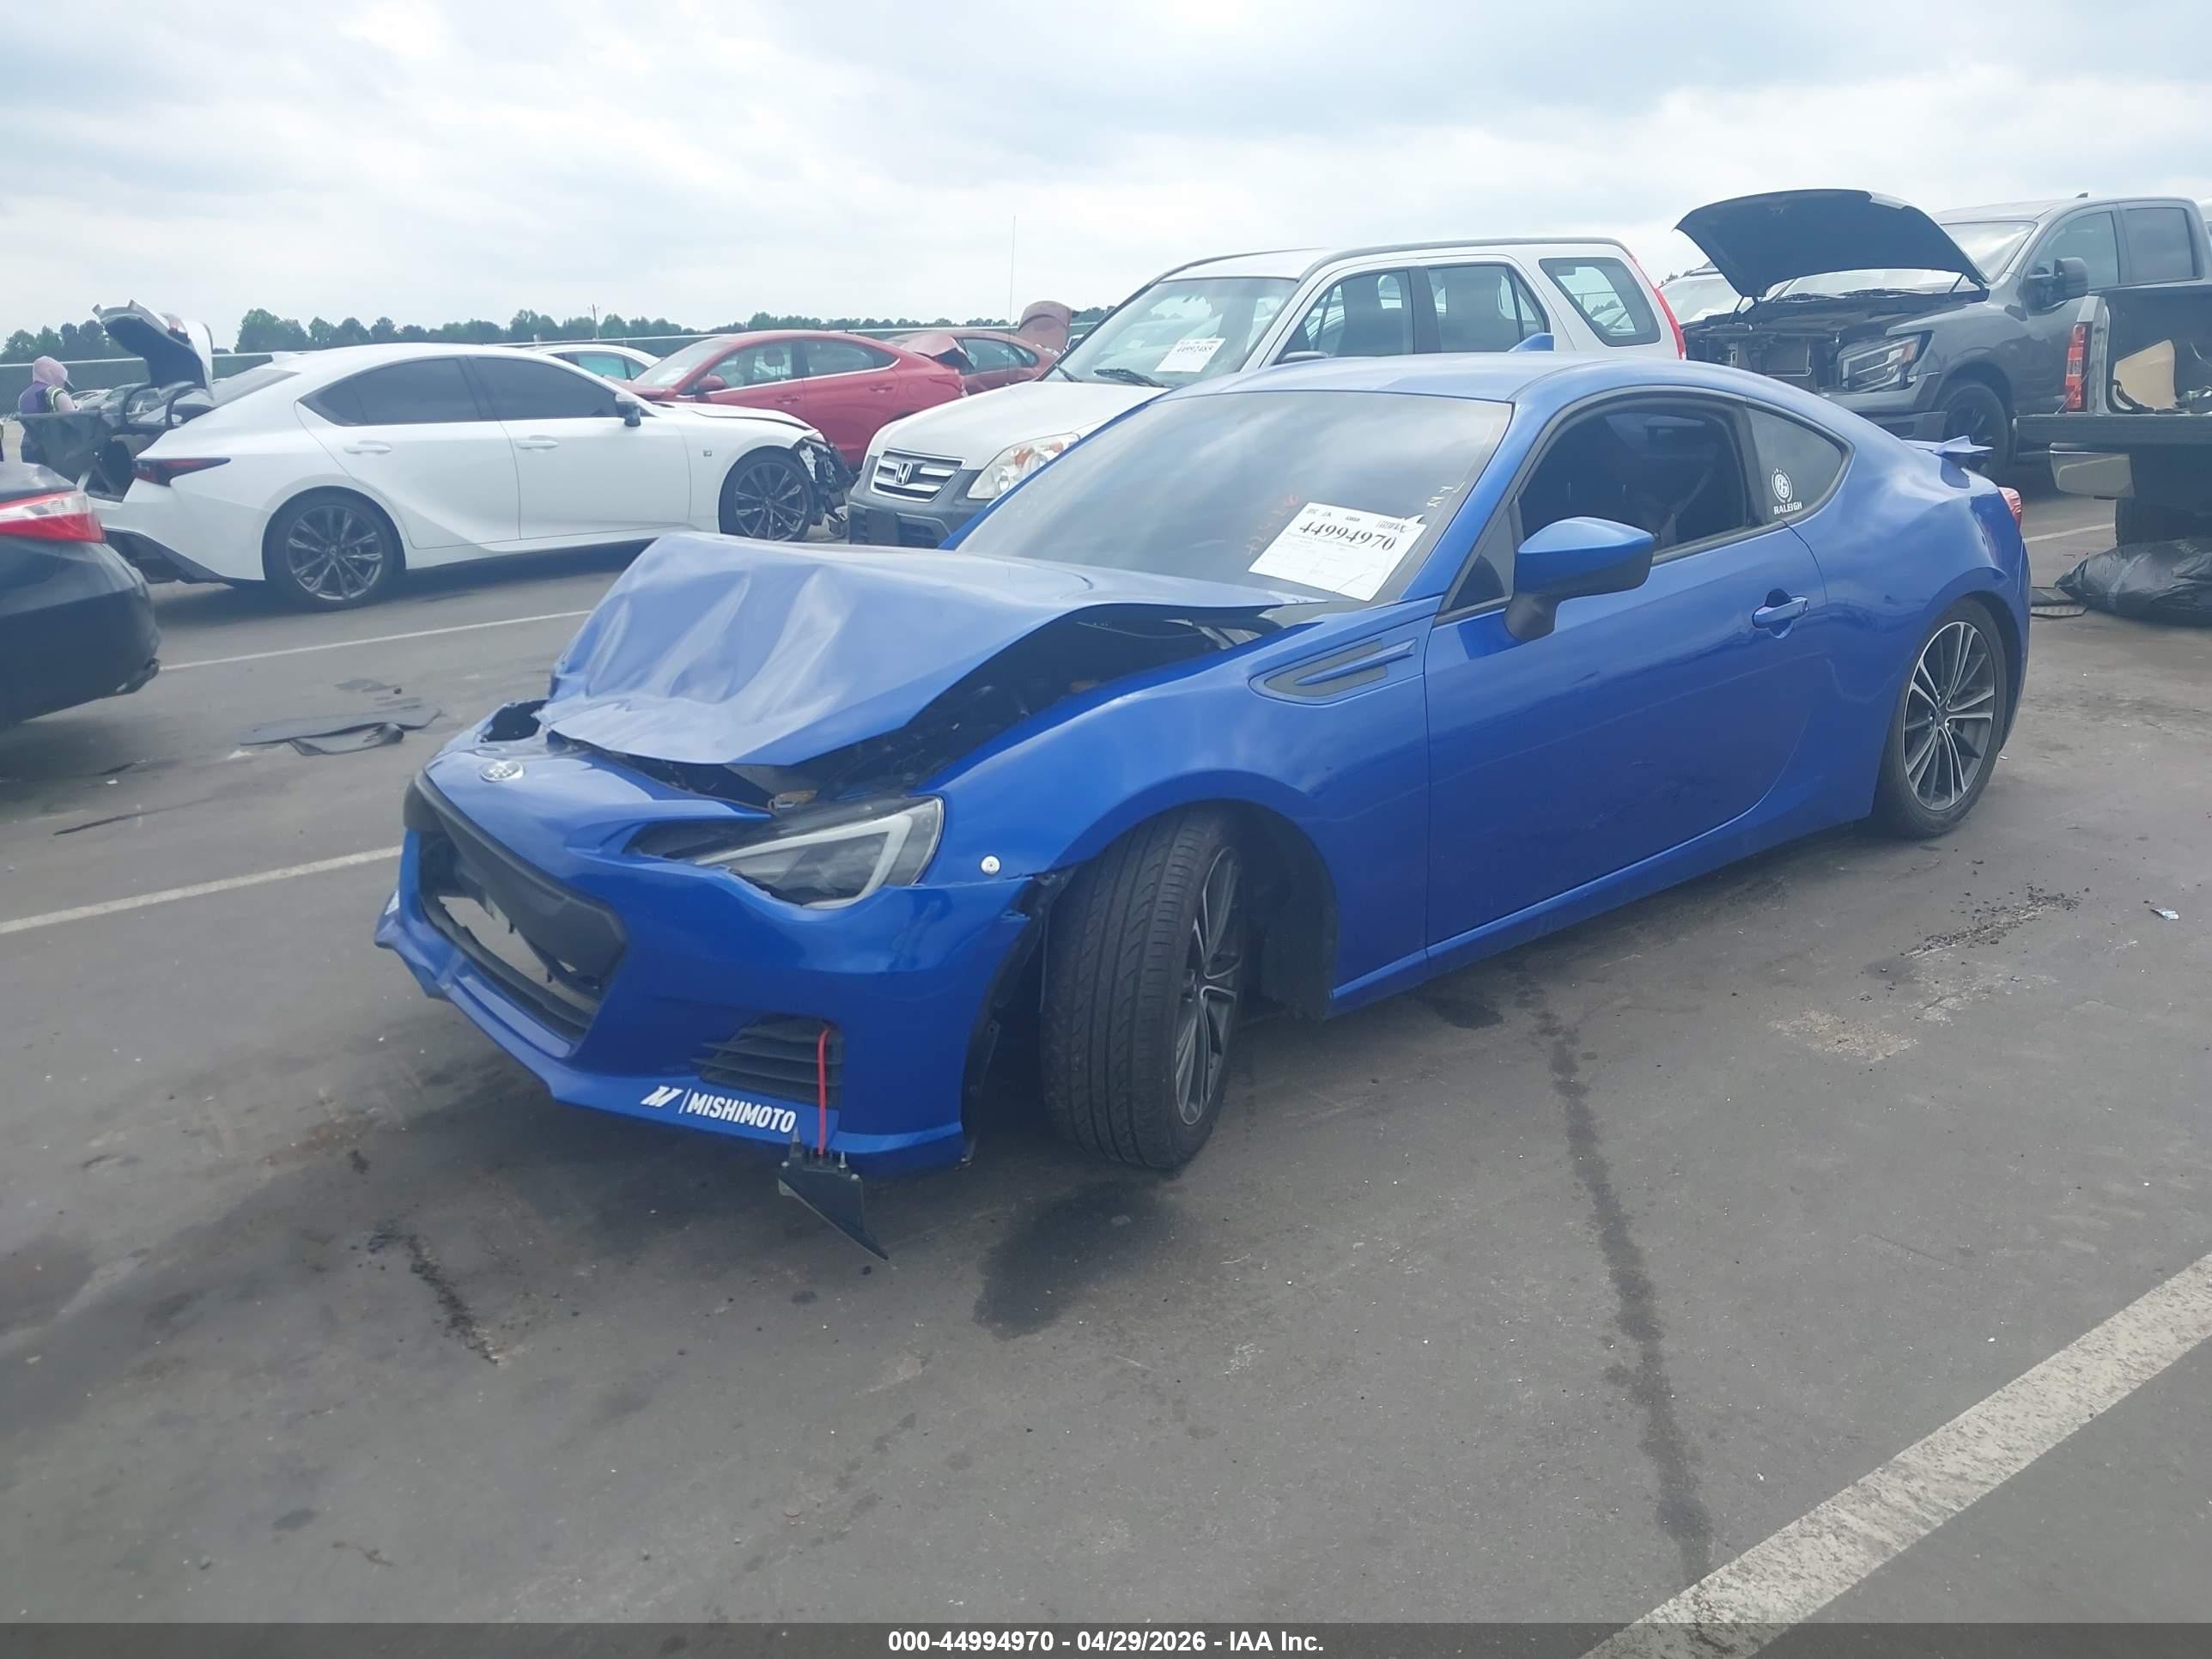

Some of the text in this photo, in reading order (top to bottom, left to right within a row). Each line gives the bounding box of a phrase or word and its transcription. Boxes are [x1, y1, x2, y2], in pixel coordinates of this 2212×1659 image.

[1773, 501, 1802, 515] RALEIGH
[1298, 520, 1398, 551] 44994970
[687, 1091, 797, 1133] MISHIMOTO
